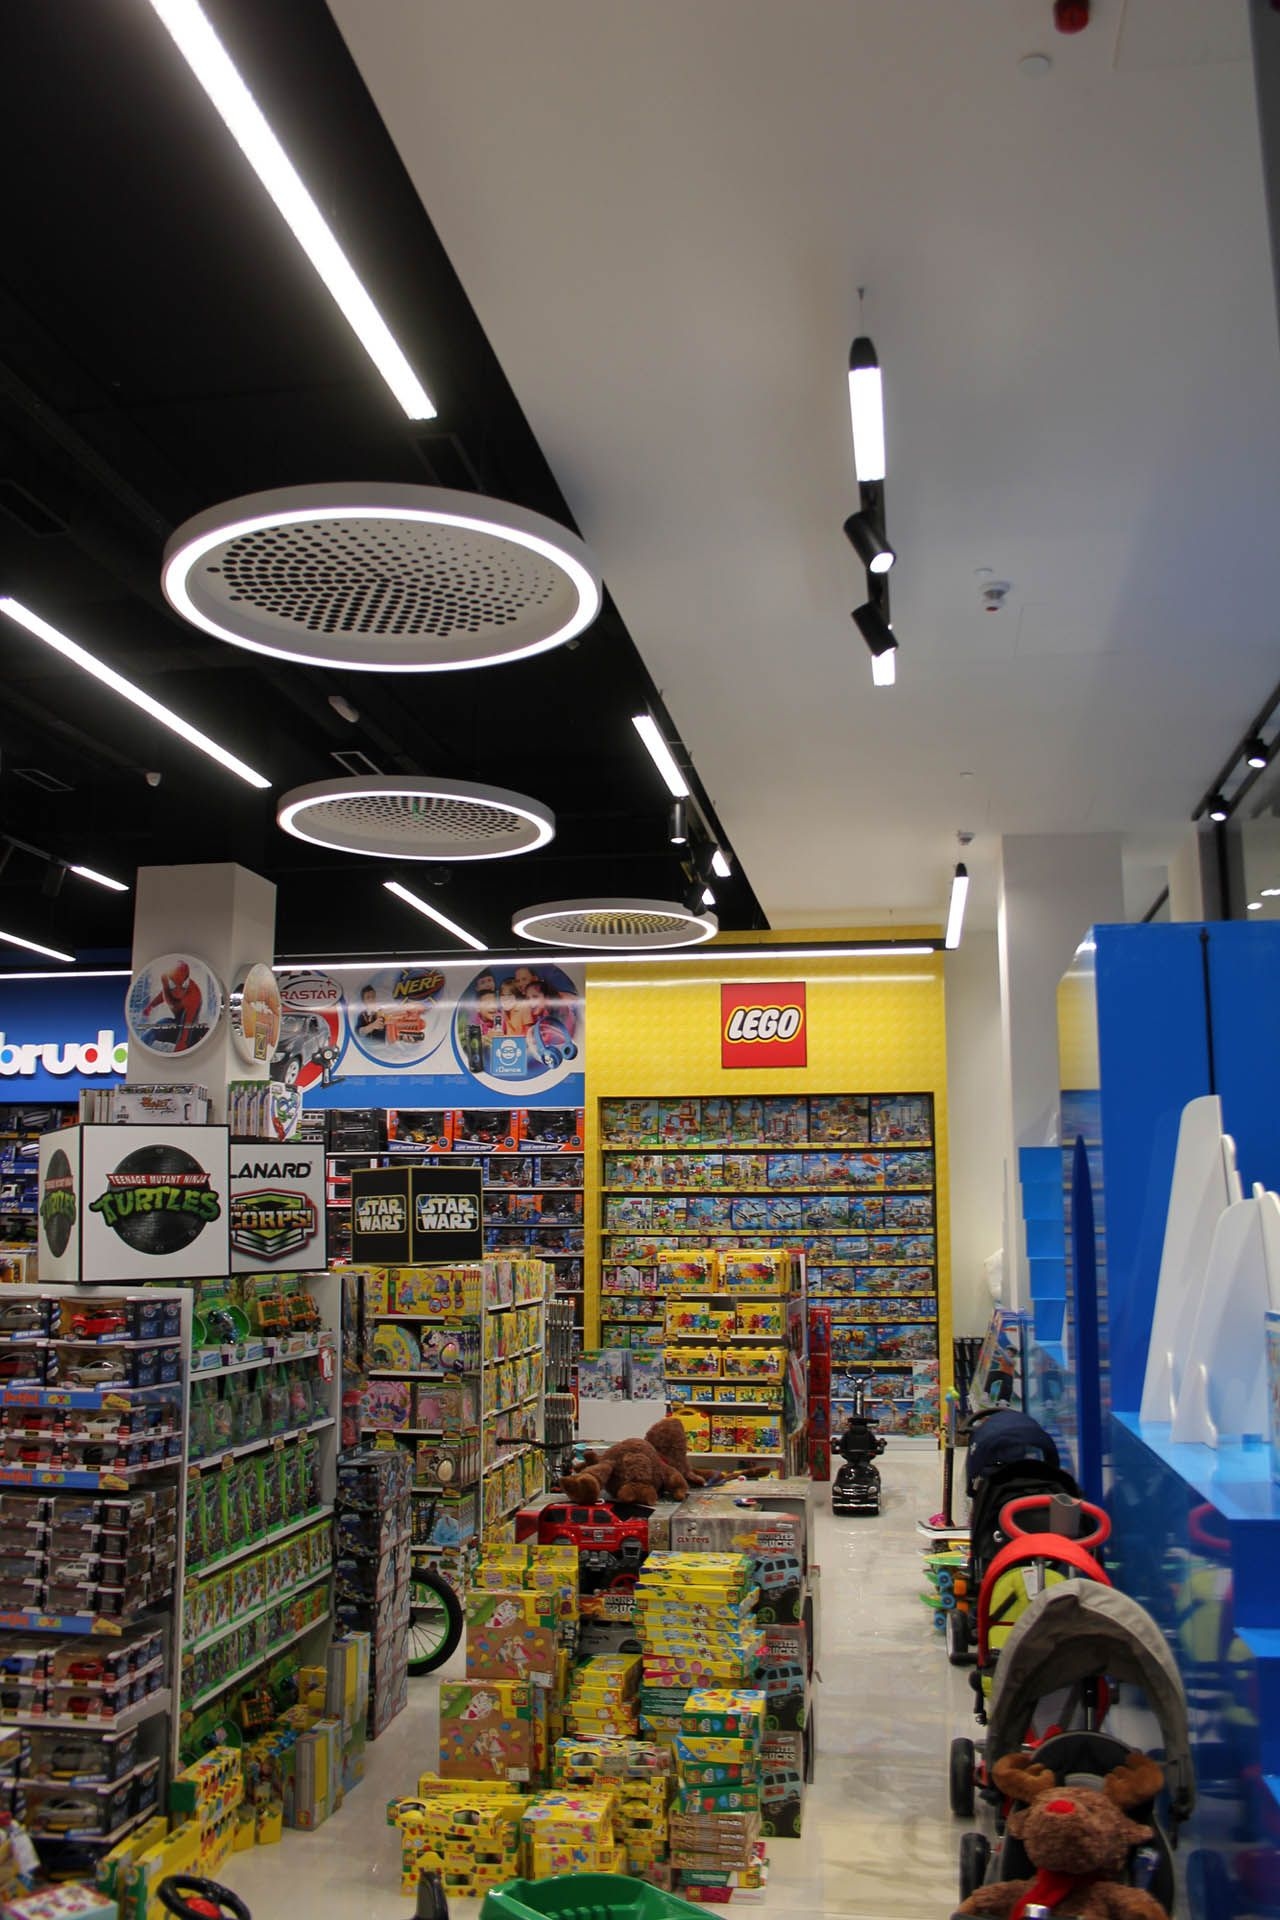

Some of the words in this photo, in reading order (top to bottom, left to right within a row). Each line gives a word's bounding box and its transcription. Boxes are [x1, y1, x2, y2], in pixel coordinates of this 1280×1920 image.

[392, 974, 442, 998] NERF
[280, 989, 337, 1000] RASTAR
[728, 1007, 800, 1040] LEGO
[109, 1175, 147, 1185] TEENAGE
[150, 1175, 181, 1184] MUTANT
[184, 1174, 207, 1184] NINJA
[90, 1186, 219, 1225] TURTLES
[359, 1199, 402, 1215] STAR
[420, 1198, 474, 1214] STAR
[359, 1213, 403, 1231] WARS
[421, 1213, 474, 1229] WARS
